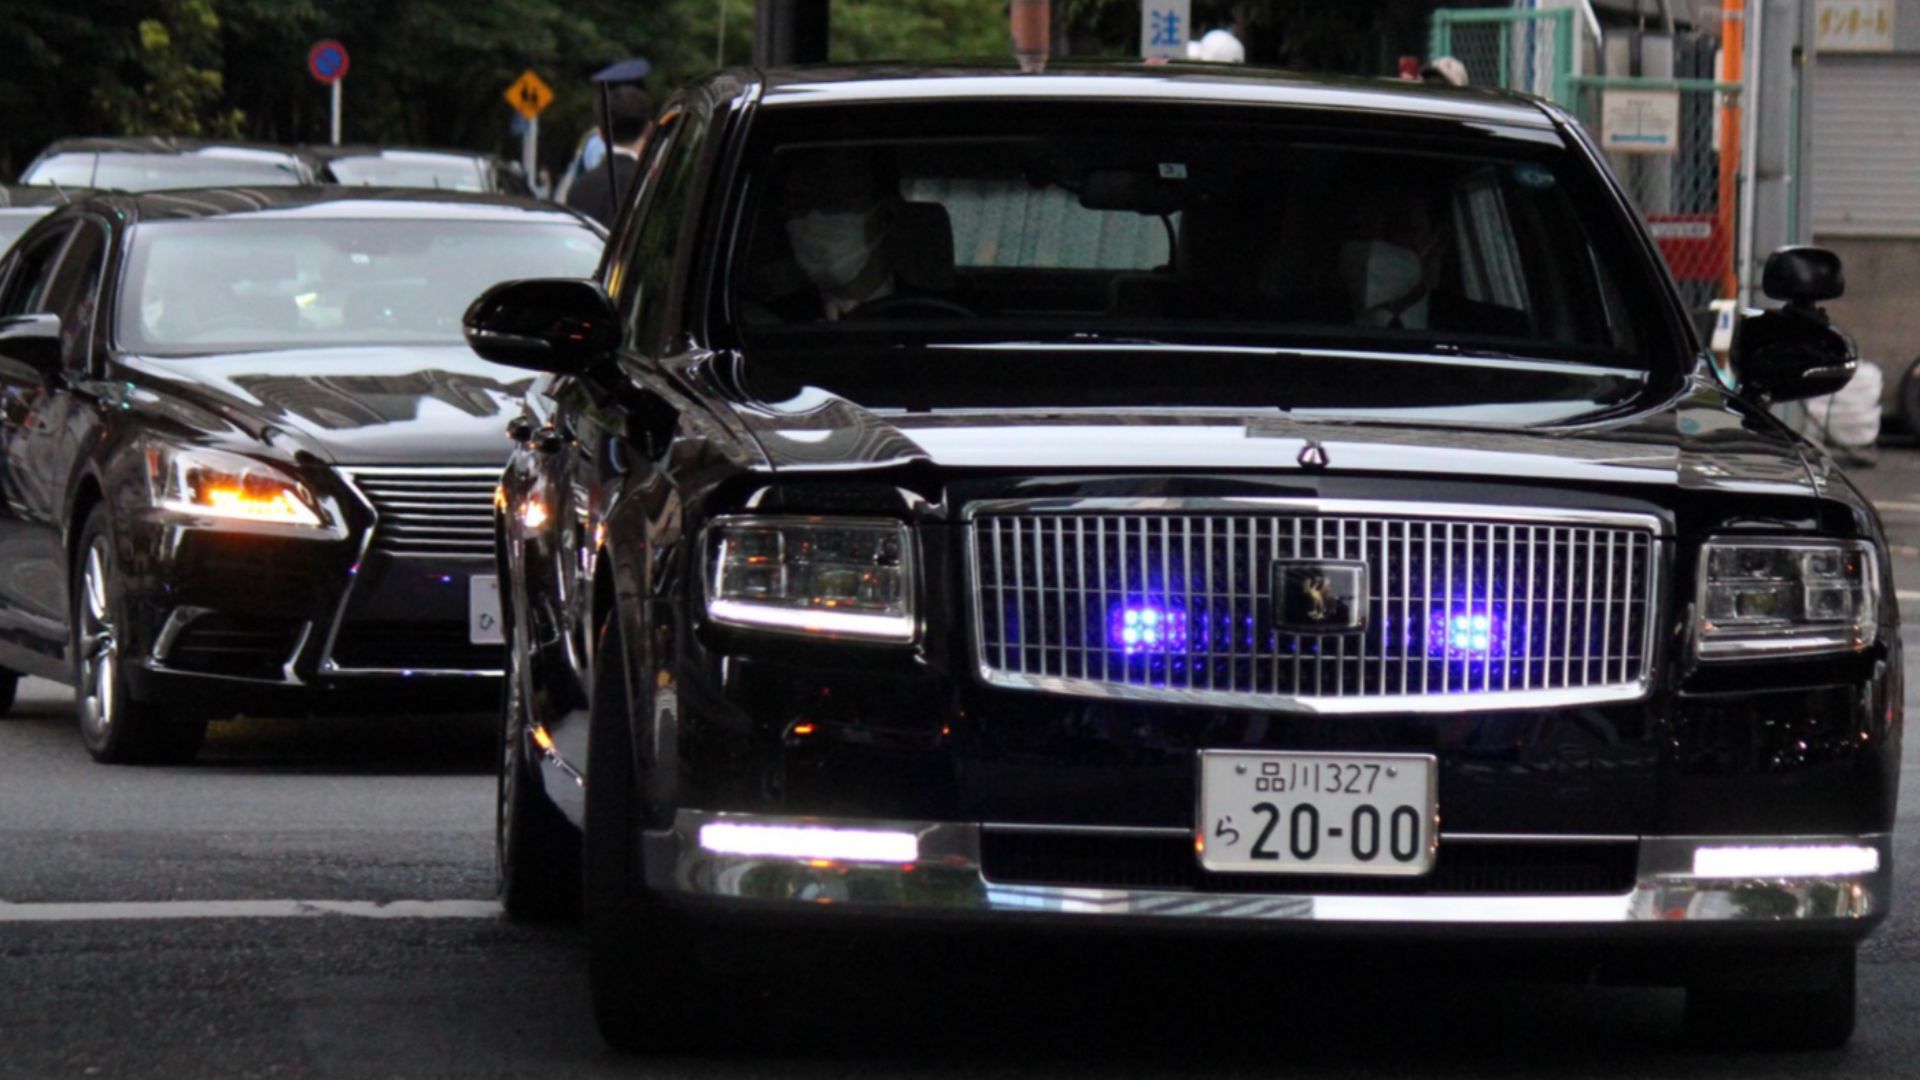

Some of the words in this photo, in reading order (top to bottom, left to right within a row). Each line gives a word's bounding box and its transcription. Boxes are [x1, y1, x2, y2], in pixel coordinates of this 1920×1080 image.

[1255, 762, 1381, 793] 品川327
[1215, 815, 1240, 846] ら
[1250, 802, 1420, 862] 20-00
